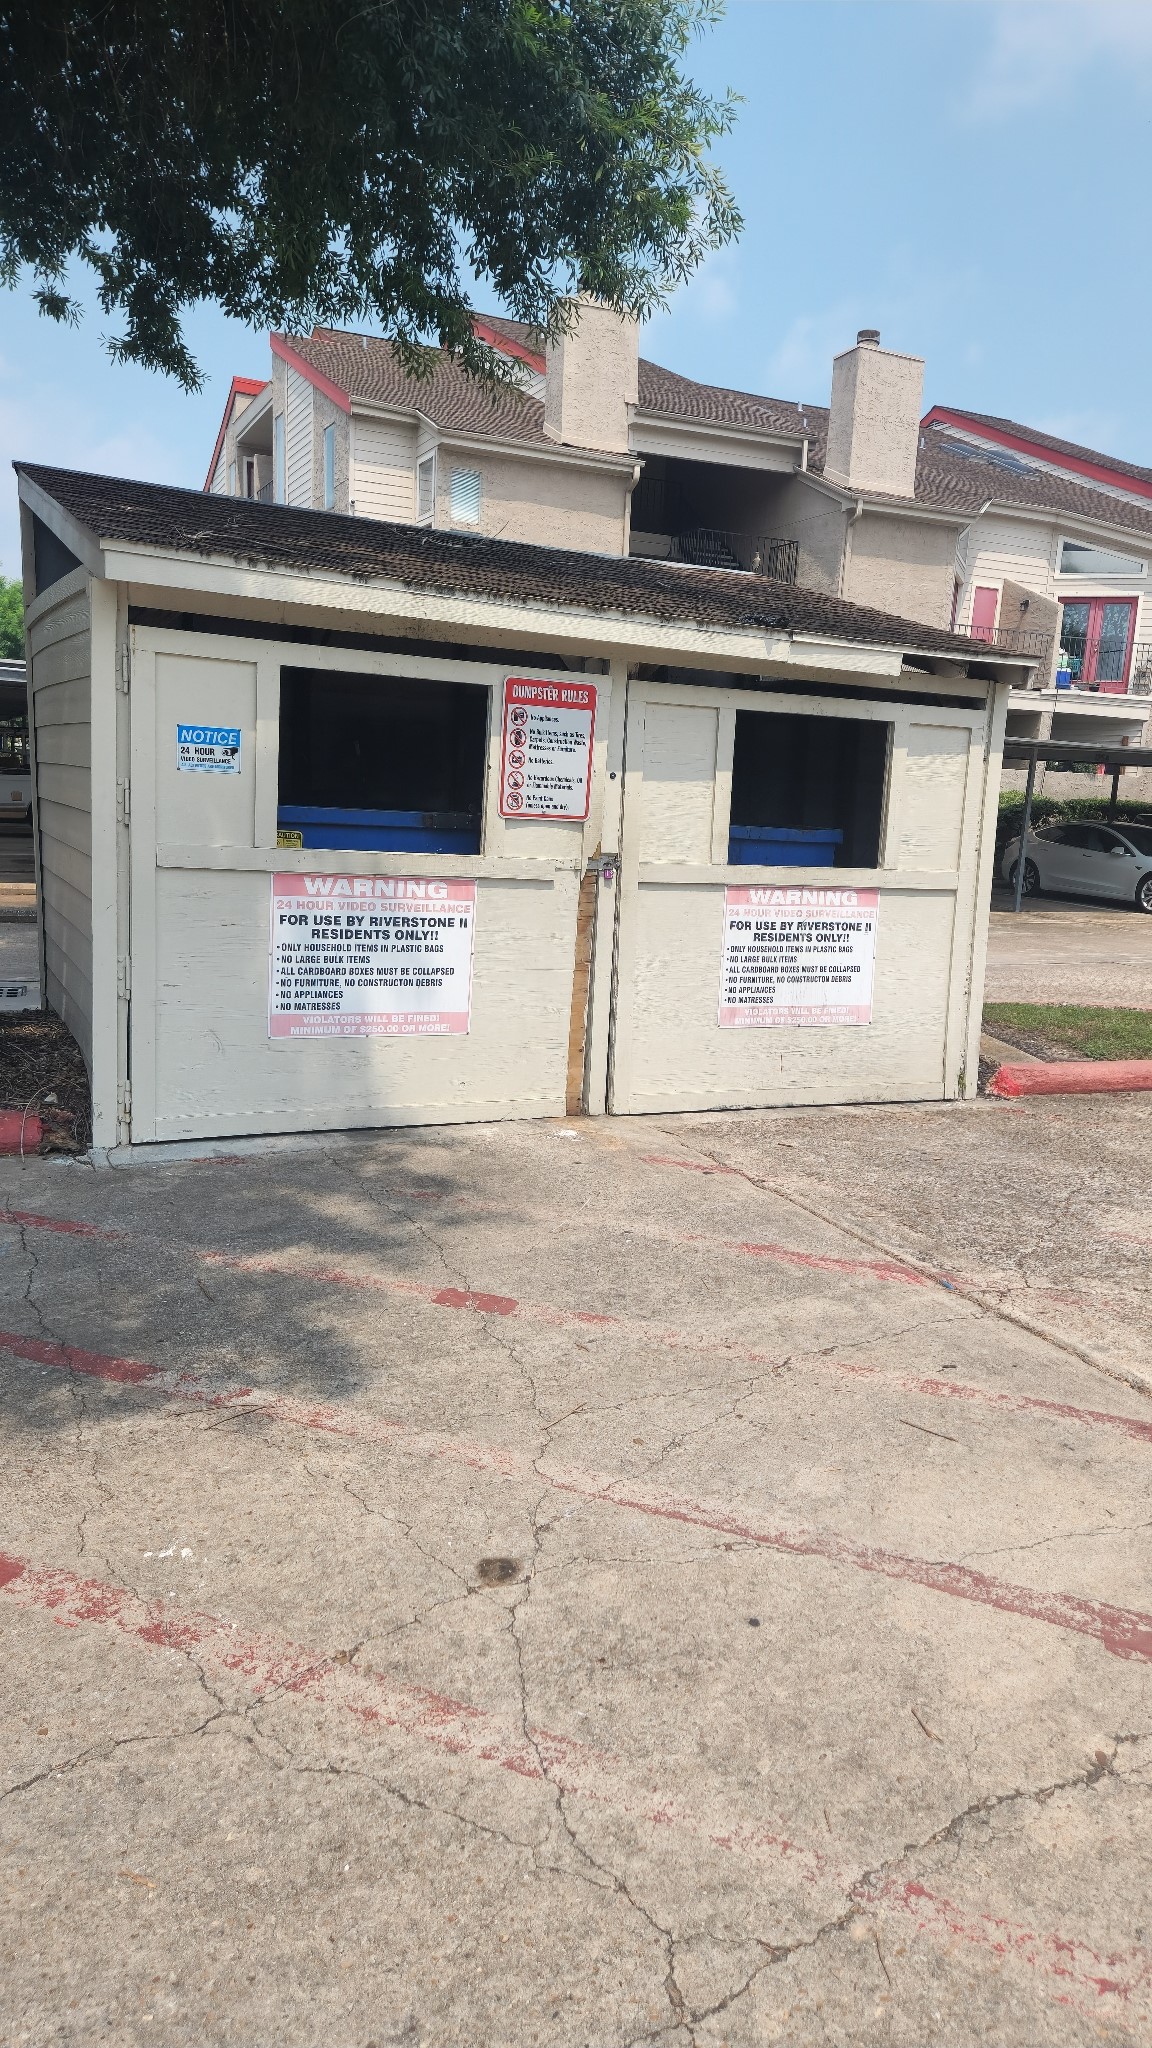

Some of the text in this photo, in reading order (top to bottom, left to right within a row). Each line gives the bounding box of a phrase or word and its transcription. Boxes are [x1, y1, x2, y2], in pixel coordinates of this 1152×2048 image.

[512, 685, 588, 703] DUMPSTER RULES
[180, 729, 238, 744] NOTICE
[180, 746, 215, 756] 24 HOUR
[304, 878, 447, 899] WARNING
[749, 889, 857, 905] WARNING
[277, 900, 470, 913] 24 HOUR VIDEO SURVEILLANCE
[744, 909, 771, 917] HOUR
[806, 910, 874, 918] SURVEILLANCE
[280, 915, 308, 925] FOR
[314, 915, 341, 926] USE
[347, 916, 365, 926] BY
[370, 917, 455, 927] RIVERSTONE
[730, 921, 751, 930] FOR
[756, 921, 776, 930] USE
[780, 922, 794, 930] BY
[797, 922, 862, 931] RIVERSTONE
[312, 929, 438, 940] RESIDENTS ONLY!!
[753, 933, 849, 942] RESIDENTS ONLY!!
[282, 944, 301, 952] ONLY
[304, 944, 351, 952] HOUSEHOLD
[355, 944, 378, 952] ITEMS
[281, 967, 454, 975] ALL CARDBOARD BOXES MUST BE COLLAPSED
[294, 979, 341, 988] FURNITURE,
[364, 1015, 388, 1023] WILL
[290, 1026, 340, 1034] MINIMUM
[360, 1025, 399, 1033] $250.00
[402, 1024, 415, 1032] OR
